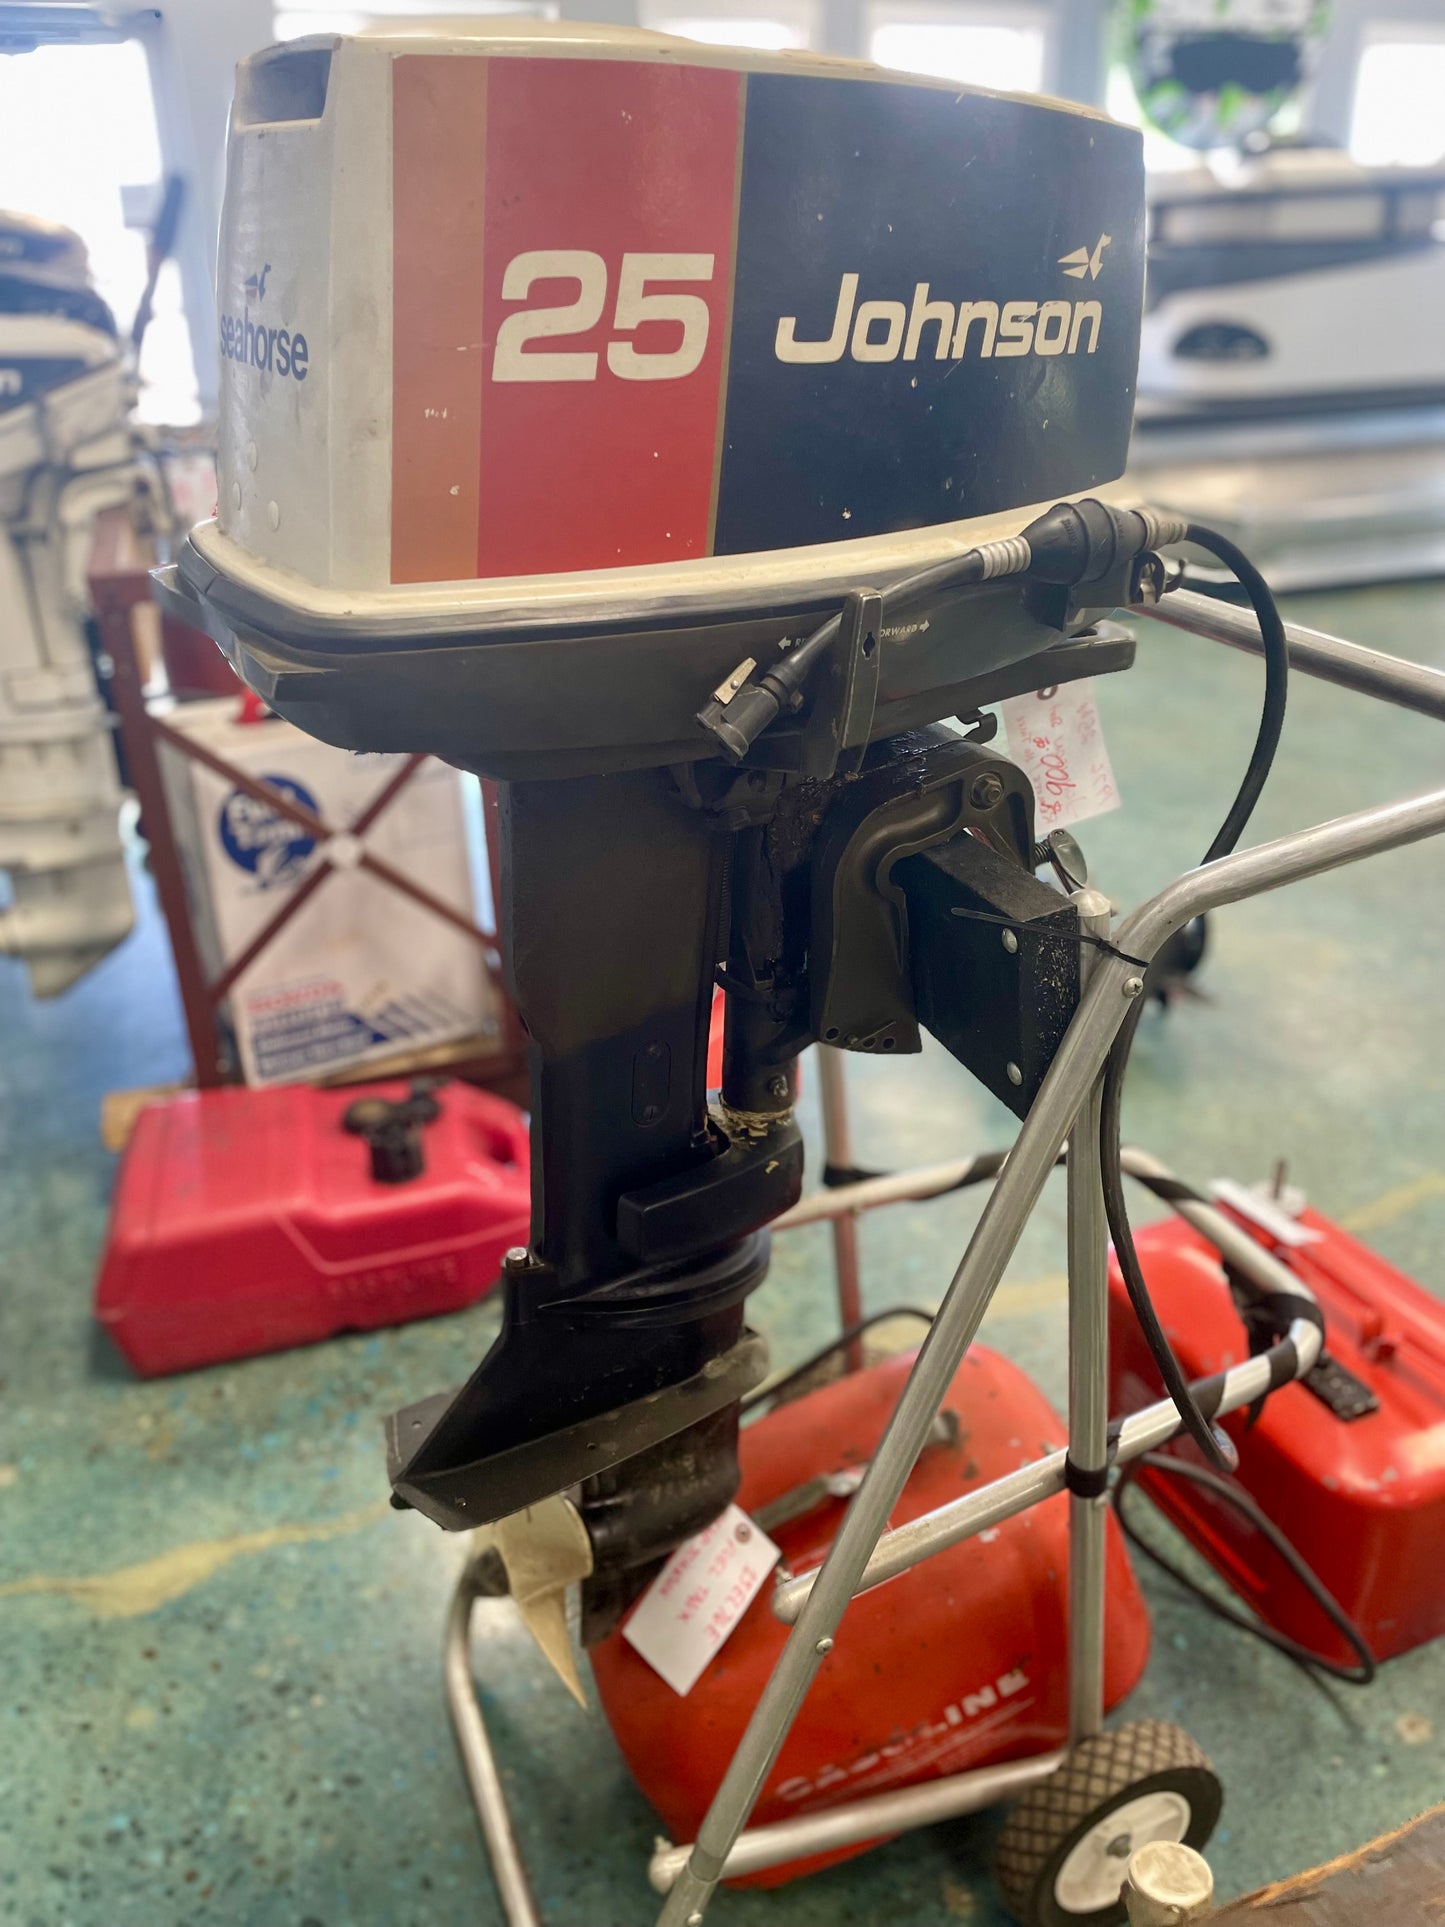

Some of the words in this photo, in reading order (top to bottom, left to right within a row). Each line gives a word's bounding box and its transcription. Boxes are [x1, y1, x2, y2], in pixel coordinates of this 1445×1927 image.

[220, 306, 308, 380] seahorse
[492, 249, 714, 381] 25
[775, 272, 1102, 363] Johnson
